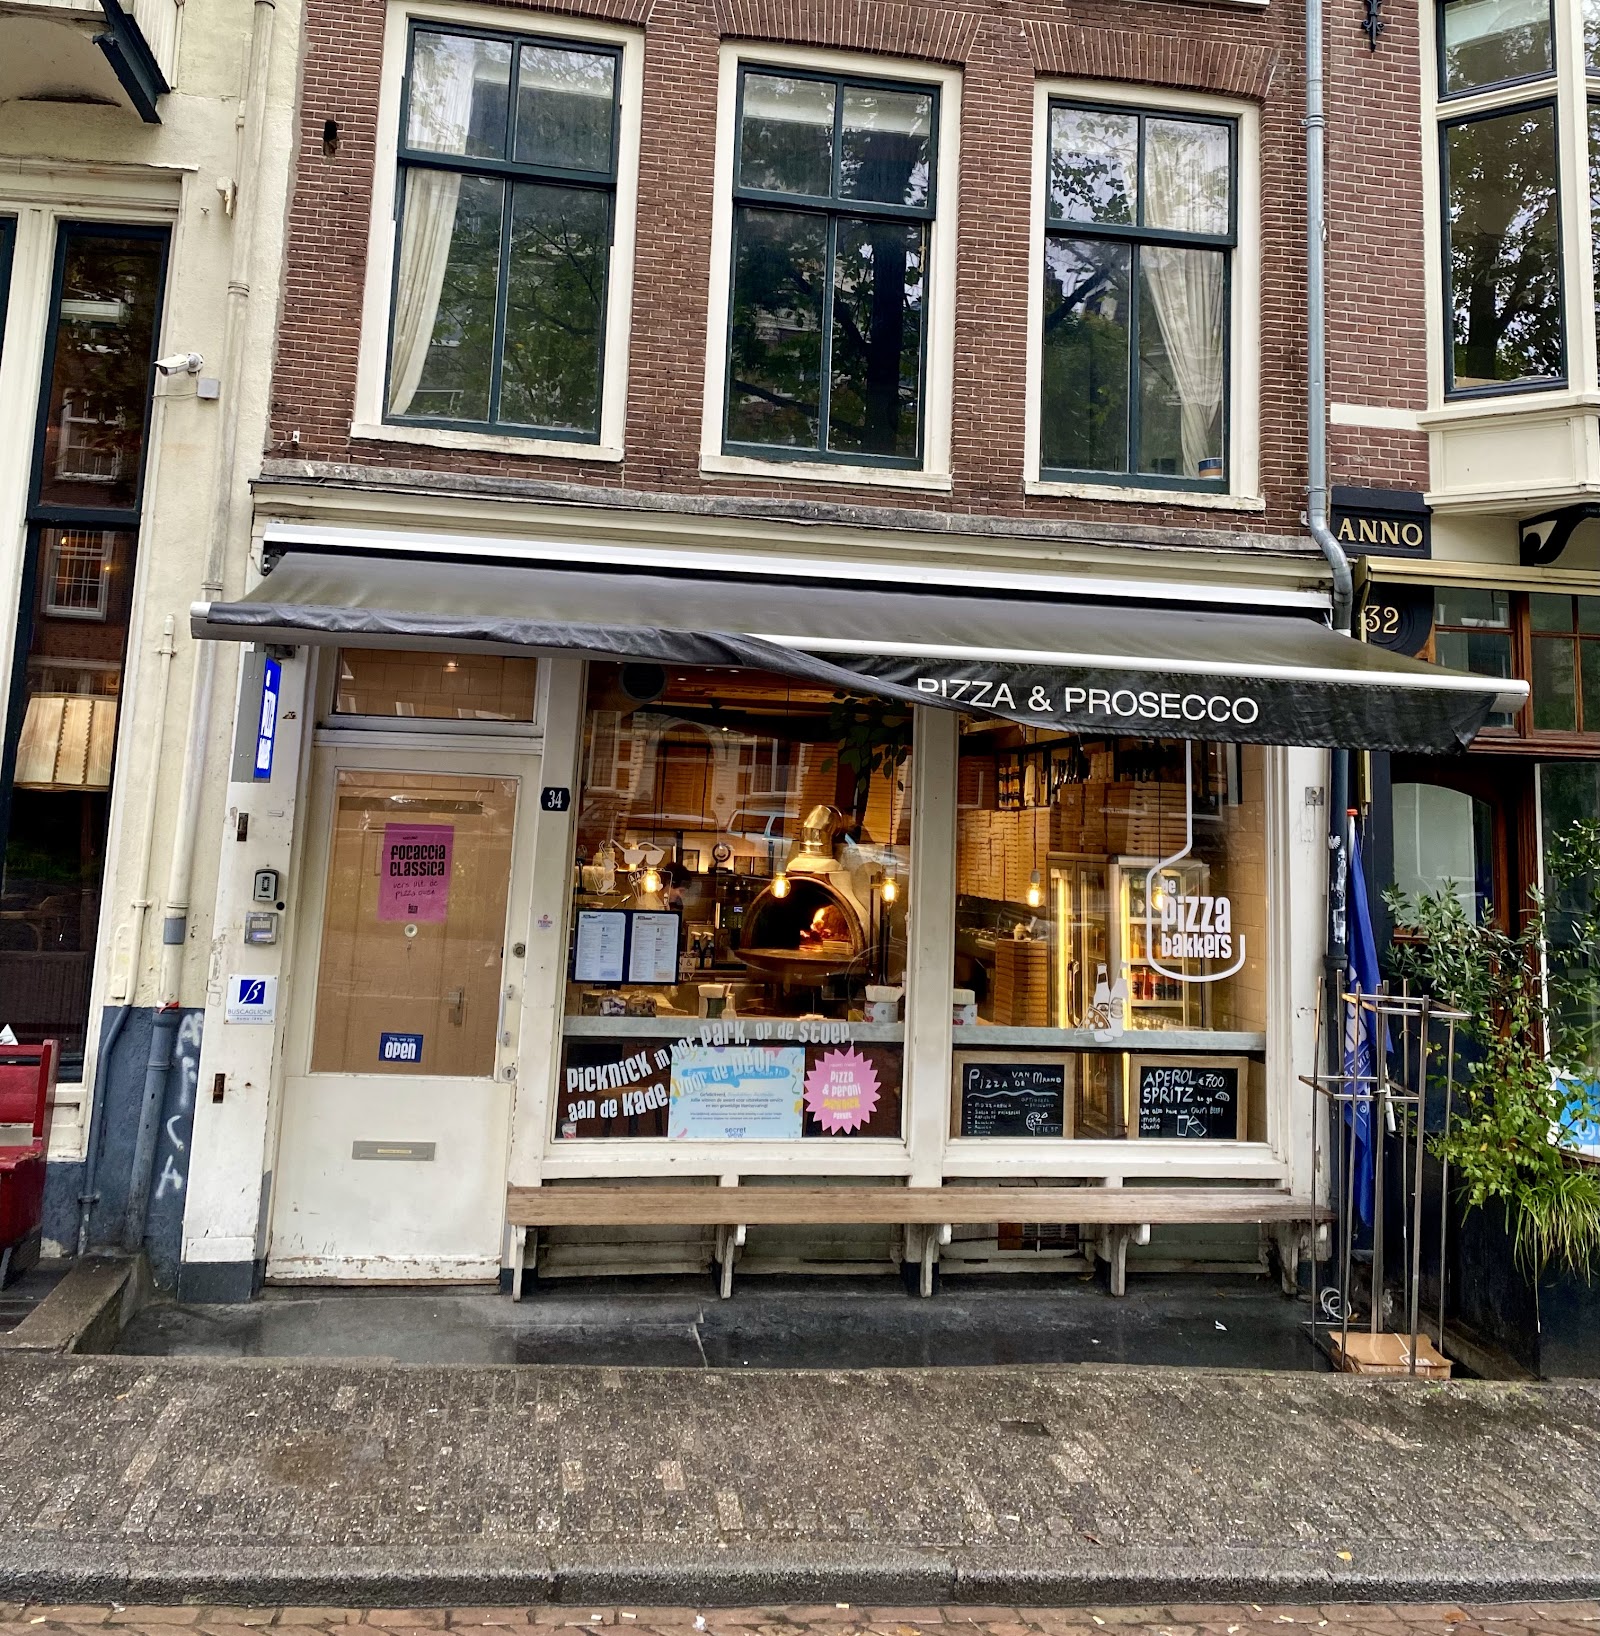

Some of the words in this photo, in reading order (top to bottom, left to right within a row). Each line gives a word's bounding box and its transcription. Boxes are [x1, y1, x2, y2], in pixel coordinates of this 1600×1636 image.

[1337, 518, 1423, 546] ANNO
[1364, 605, 1399, 634] 32
[917, 677, 1016, 709] PIZZA
[1028, 685, 1053, 712] &
[1065, 687, 1259, 724] PROSECCO
[547, 789, 563, 809] 34
[429, 879, 438, 887] de
[1161, 933, 1232, 959] bakkers
[384, 1041, 416, 1060] open
[653, 1048, 670, 1070] in
[669, 1035, 698, 1061] het
[755, 1022, 772, 1040] op
[777, 1022, 794, 1040] de
[1143, 1069, 1196, 1087] APEROL
[567, 1099, 596, 1122] aan
[600, 1099, 618, 1119] de
[711, 1064, 729, 1082] de
